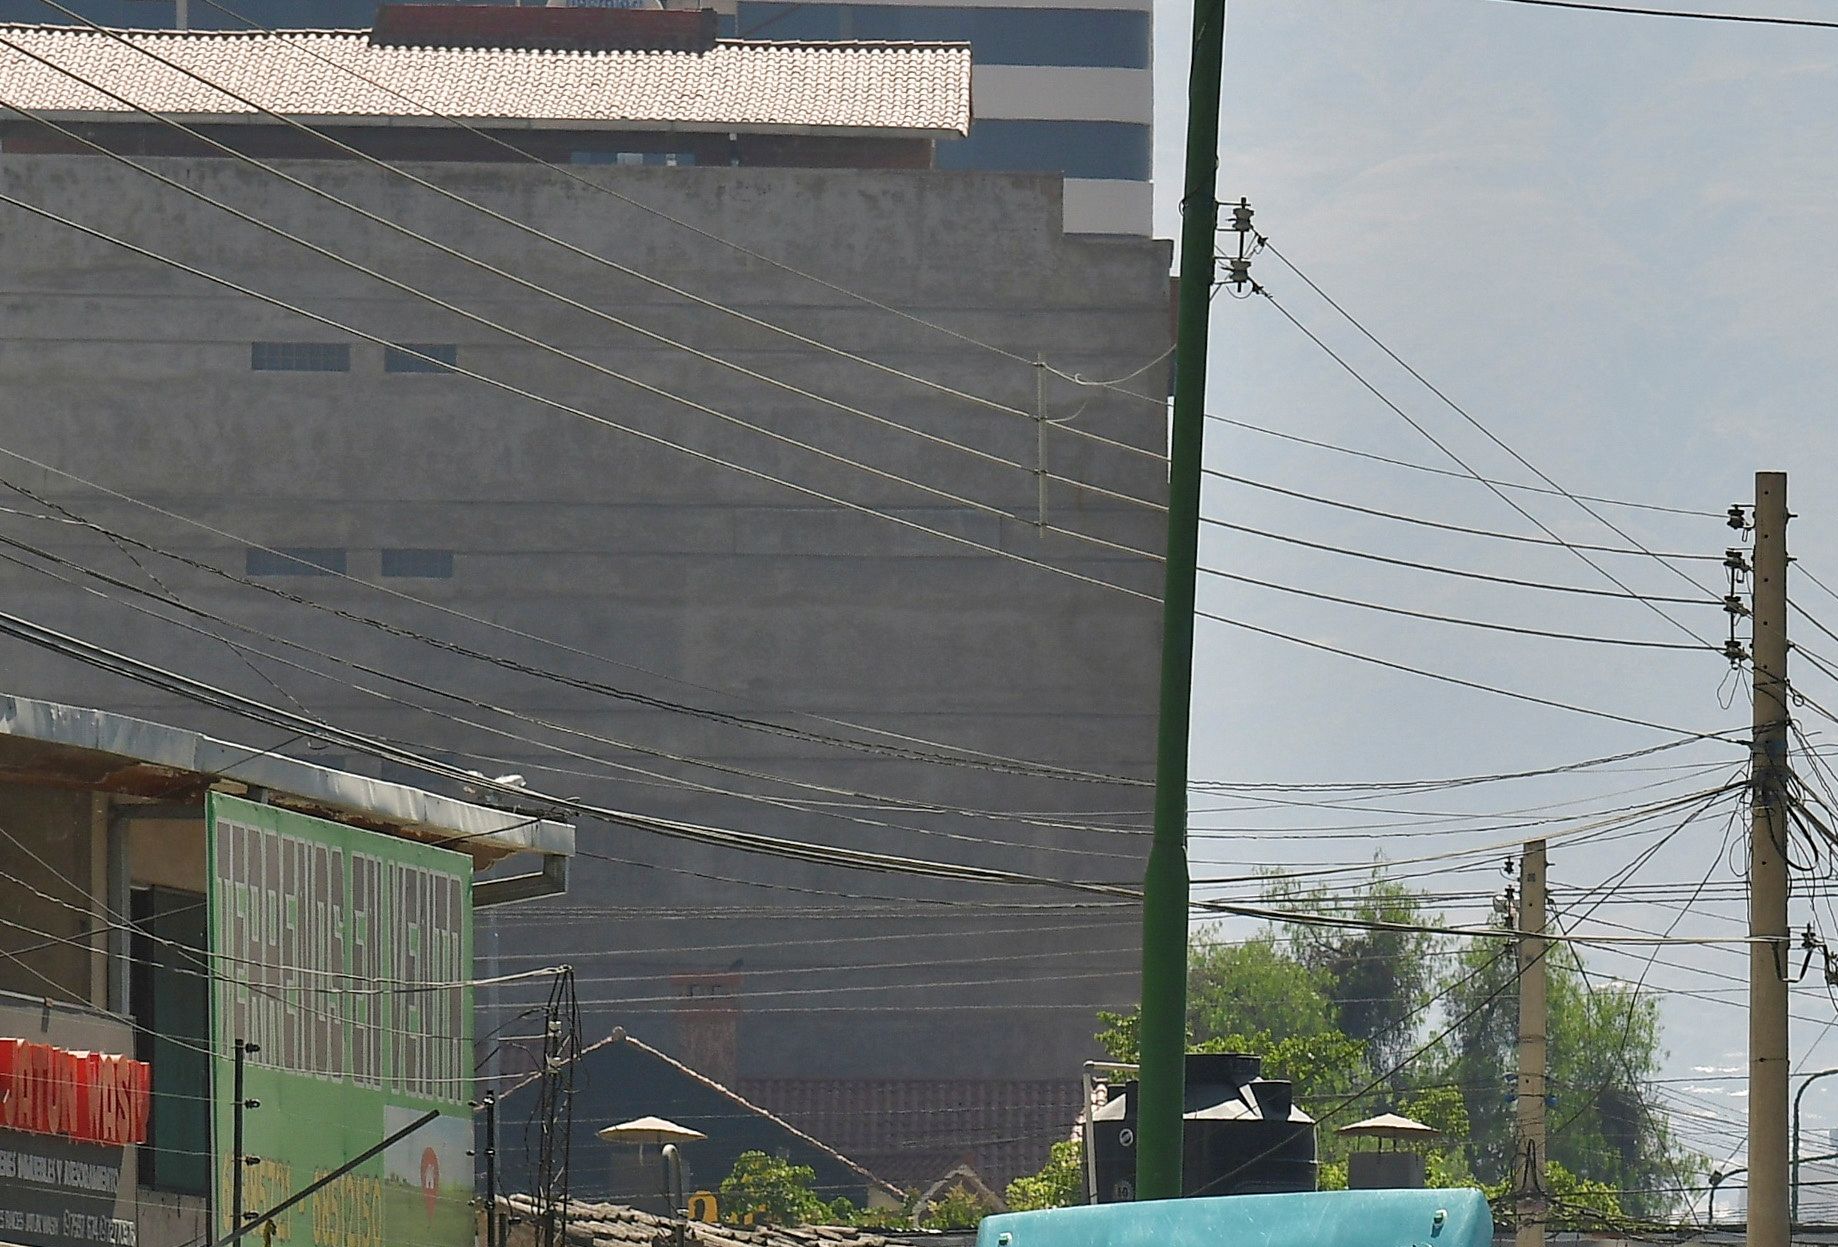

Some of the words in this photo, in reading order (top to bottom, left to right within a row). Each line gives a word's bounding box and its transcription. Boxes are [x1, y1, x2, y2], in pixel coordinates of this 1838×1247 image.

[217, 817, 345, 1082] TERRENOS
[351, 851, 383, 1091] EN
[388, 859, 464, 1105] VENTA
[4, 1041, 78, 1132] JATUN
